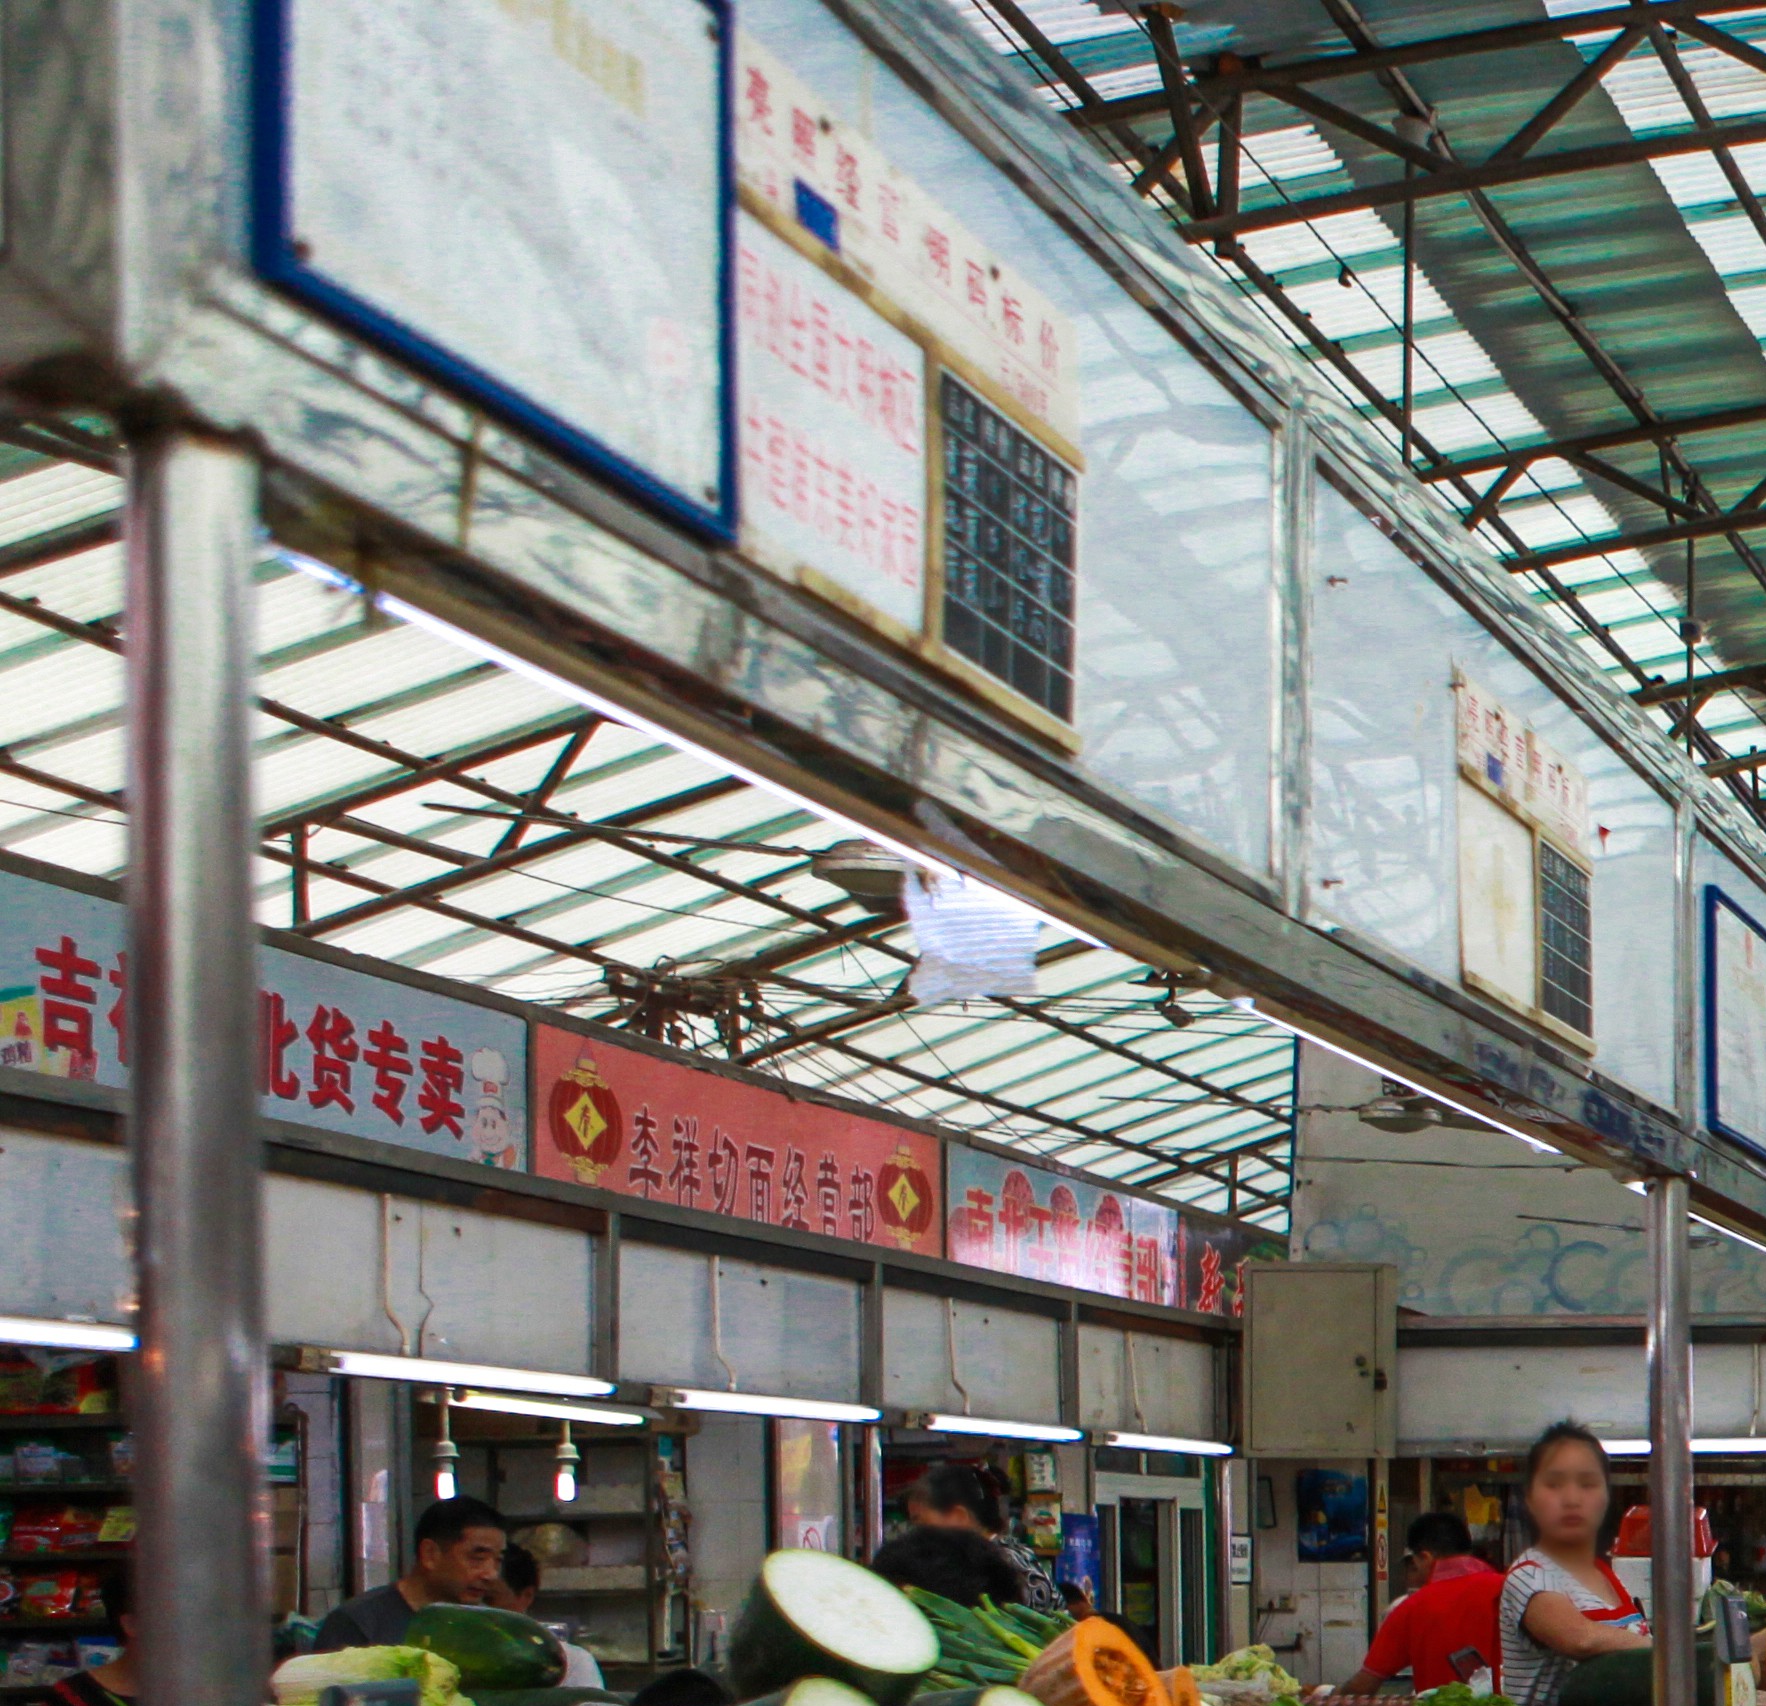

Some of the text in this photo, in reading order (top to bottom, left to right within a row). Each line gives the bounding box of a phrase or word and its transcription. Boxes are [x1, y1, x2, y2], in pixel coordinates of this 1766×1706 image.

[628, 1103, 876, 1243] 李祥切面经营部
